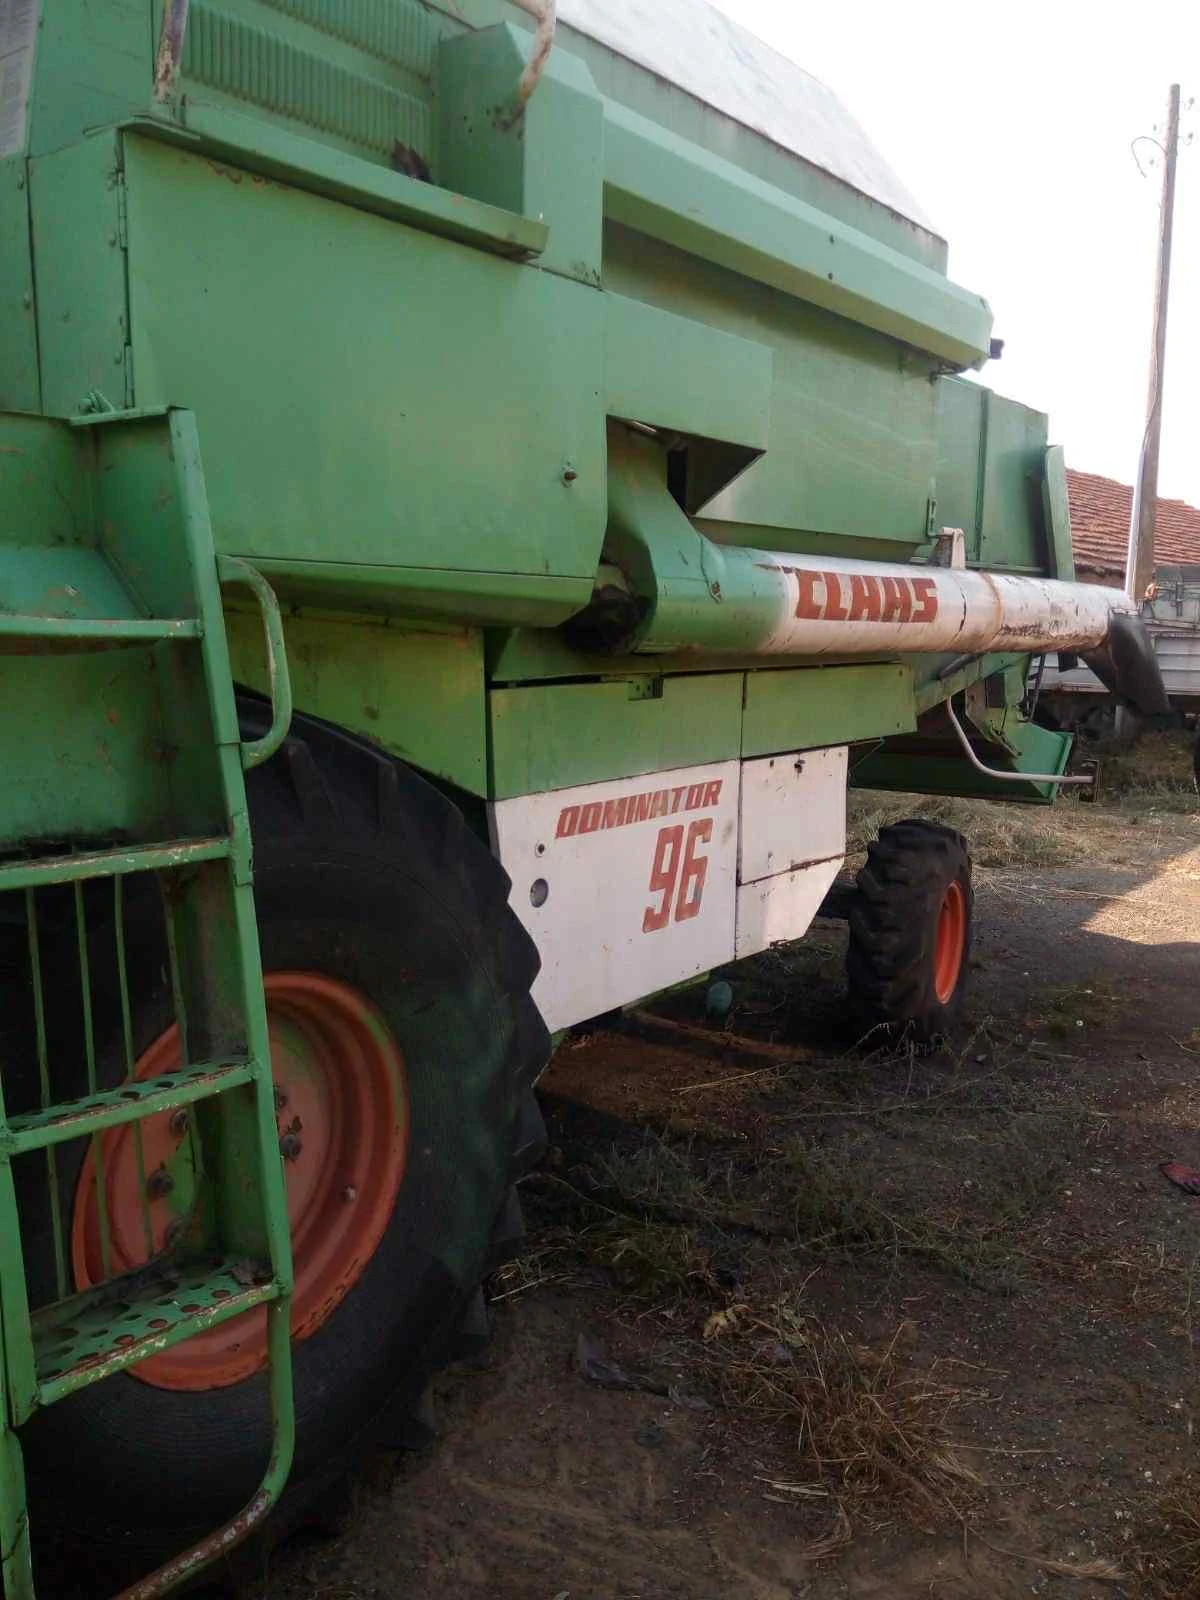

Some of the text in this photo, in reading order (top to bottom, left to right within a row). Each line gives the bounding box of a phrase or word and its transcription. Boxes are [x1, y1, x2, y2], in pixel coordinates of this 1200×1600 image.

[796, 569, 938, 623] CLAAS
[555, 780, 723, 839] DOMINATOR
[642, 818, 713, 934] 96
